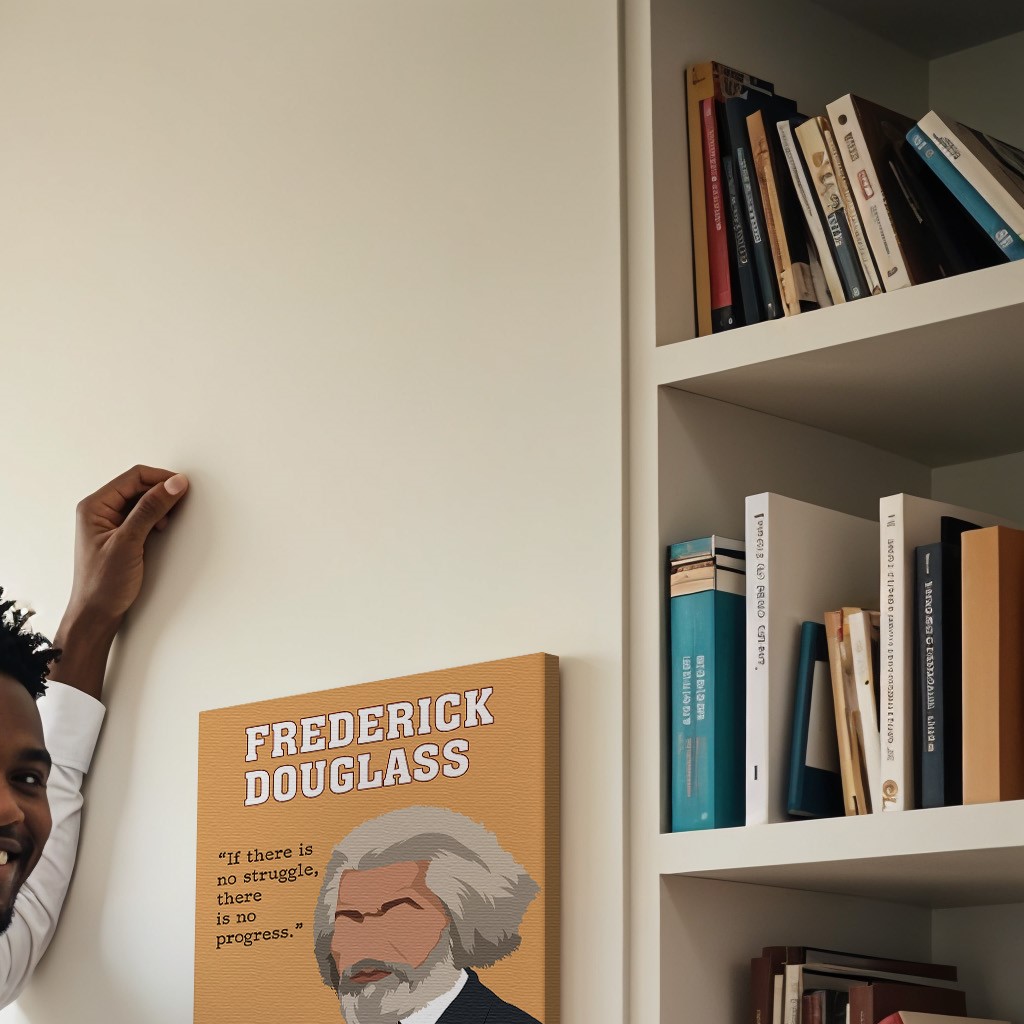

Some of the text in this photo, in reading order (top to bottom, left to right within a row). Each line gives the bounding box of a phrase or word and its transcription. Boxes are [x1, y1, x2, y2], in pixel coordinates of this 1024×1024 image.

[244, 686, 495, 762] FREDERICK
[243, 738, 470, 806] DOUGLASS
[218, 843, 314, 866] “If there is
[217, 863, 319, 887] no struggle,
[217, 890, 262, 907] there
[216, 912, 257, 926] is no
[215, 922, 303, 950] progress.”
